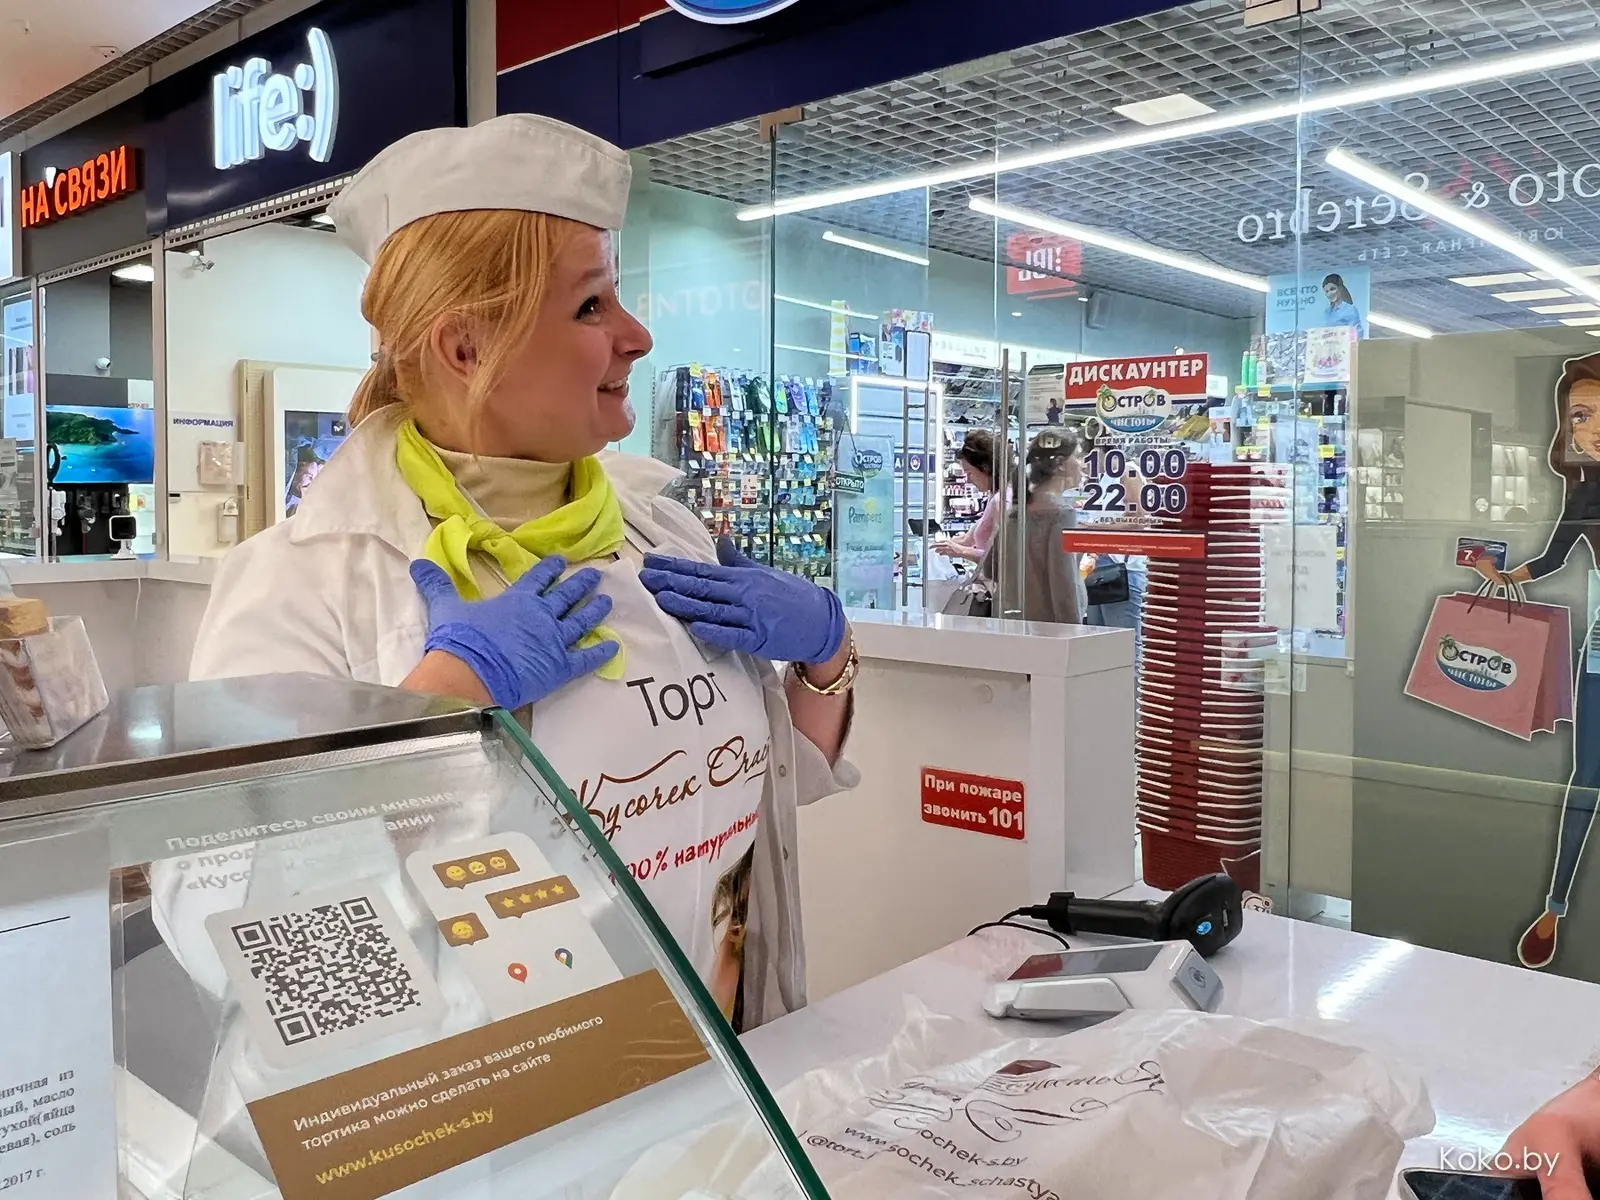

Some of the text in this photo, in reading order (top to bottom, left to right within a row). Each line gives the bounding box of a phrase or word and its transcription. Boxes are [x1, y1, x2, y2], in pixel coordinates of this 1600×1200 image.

[20, 180, 50, 229] НА
[52, 145, 130, 217] СВЯЗИ
[1068, 358, 1204, 387] ДИСКАУНТЕР
[1101, 391, 1166, 412] ОСТРОВ
[172, 417, 234, 428] ИНФОРМАЦИЯ
[1083, 449, 1187, 479] 10.00
[835, 479, 864, 489] ОТКРЫТО
[1082, 483, 1187, 513] 22.00
[1441, 646, 1512, 675] ОСТРОВ
[924, 773, 1022, 804] При пожаре
[164, 819, 308, 852] Поделитесь
[311, 804, 377, 826] своим
[923, 803, 1024, 832] звонить 101
[292, 1015, 604, 1132] Индивидуальный заказ вашего любимого
[32, 1087, 75, 1108] масло
[301, 1051, 552, 1151] тортика можно сделать на сайте
[43, 1122, 76, 1139] соль
[315, 1107, 495, 1186] www.kusochek-s.by
